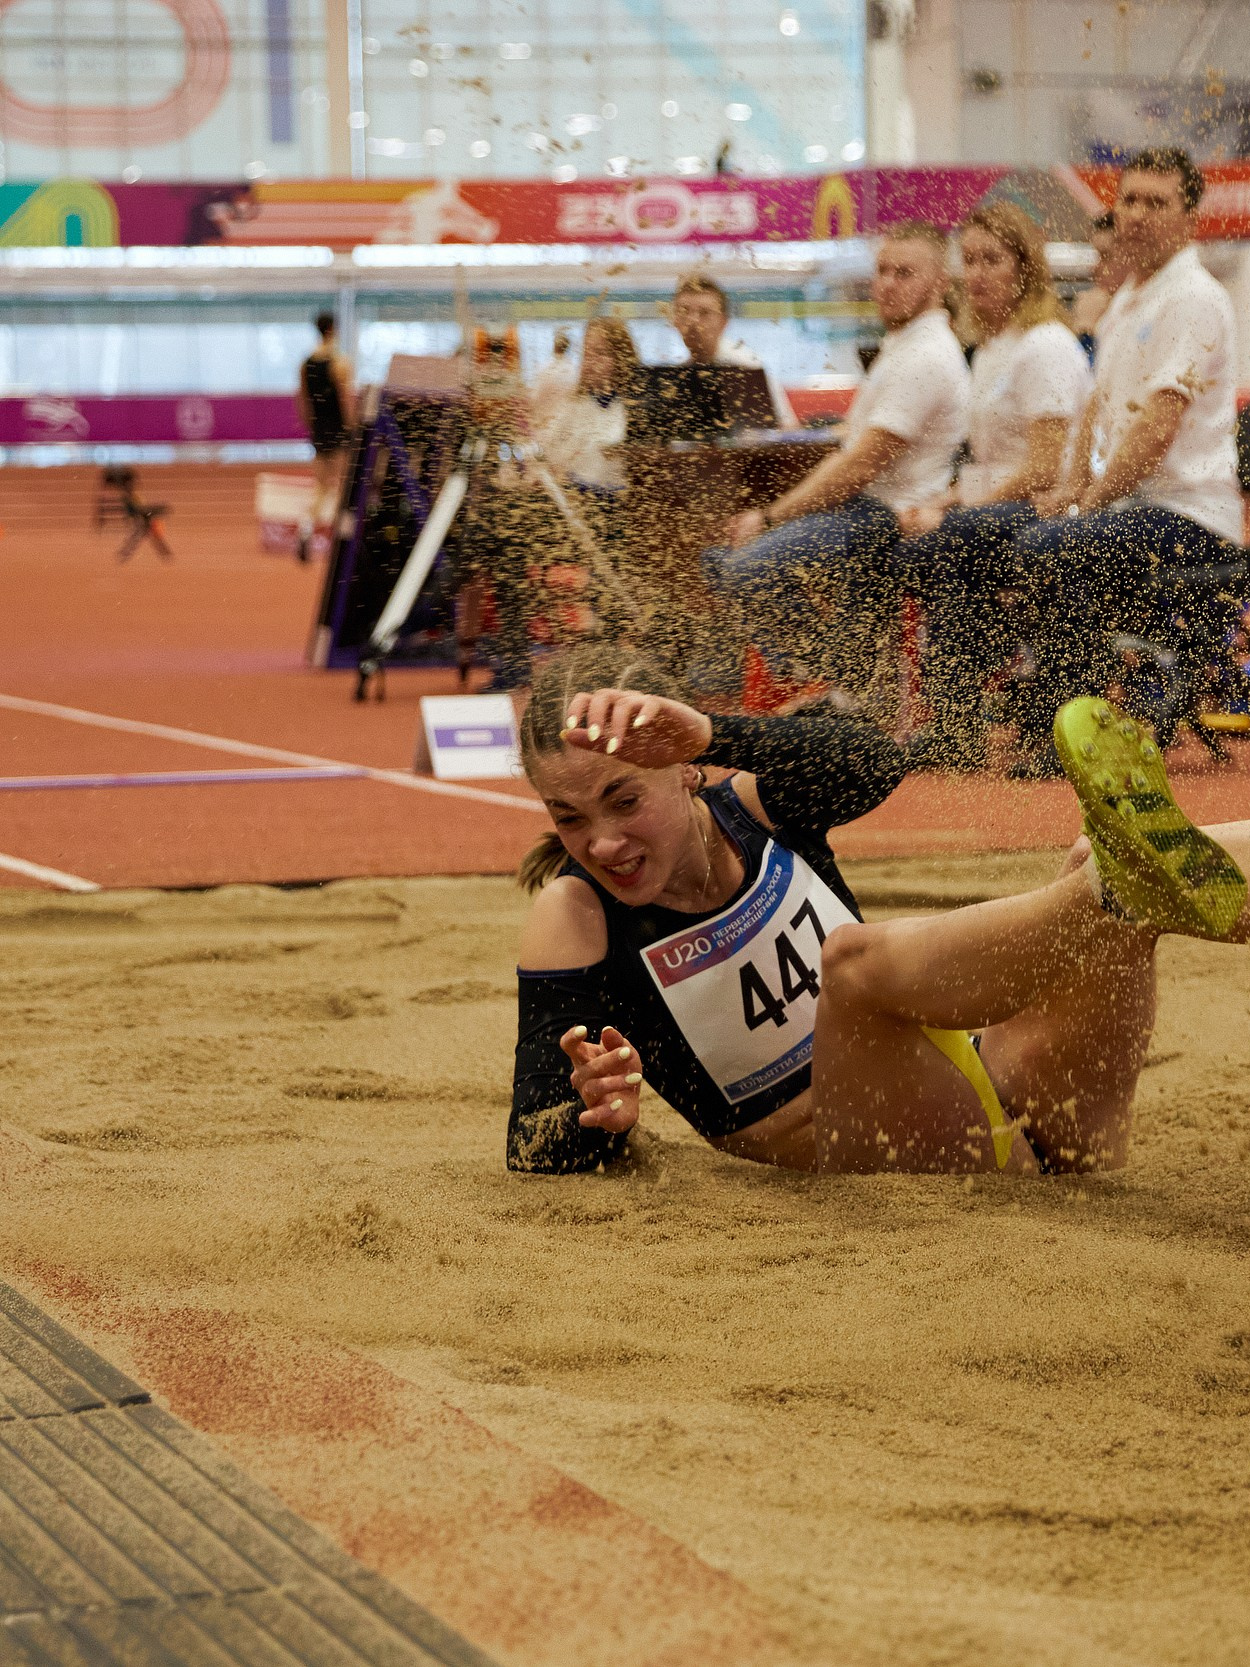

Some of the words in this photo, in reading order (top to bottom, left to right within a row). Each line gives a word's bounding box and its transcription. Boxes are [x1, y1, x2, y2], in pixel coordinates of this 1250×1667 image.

[711, 892, 767, 940] ПЕРВЕНСТВО
[716, 939, 725, 948] В
[725, 891, 778, 943] ПОМЕЩЕНИИ
[662, 937, 712, 969] U20
[738, 897, 827, 1031] 447
[794, 1042, 813, 1060] 202
